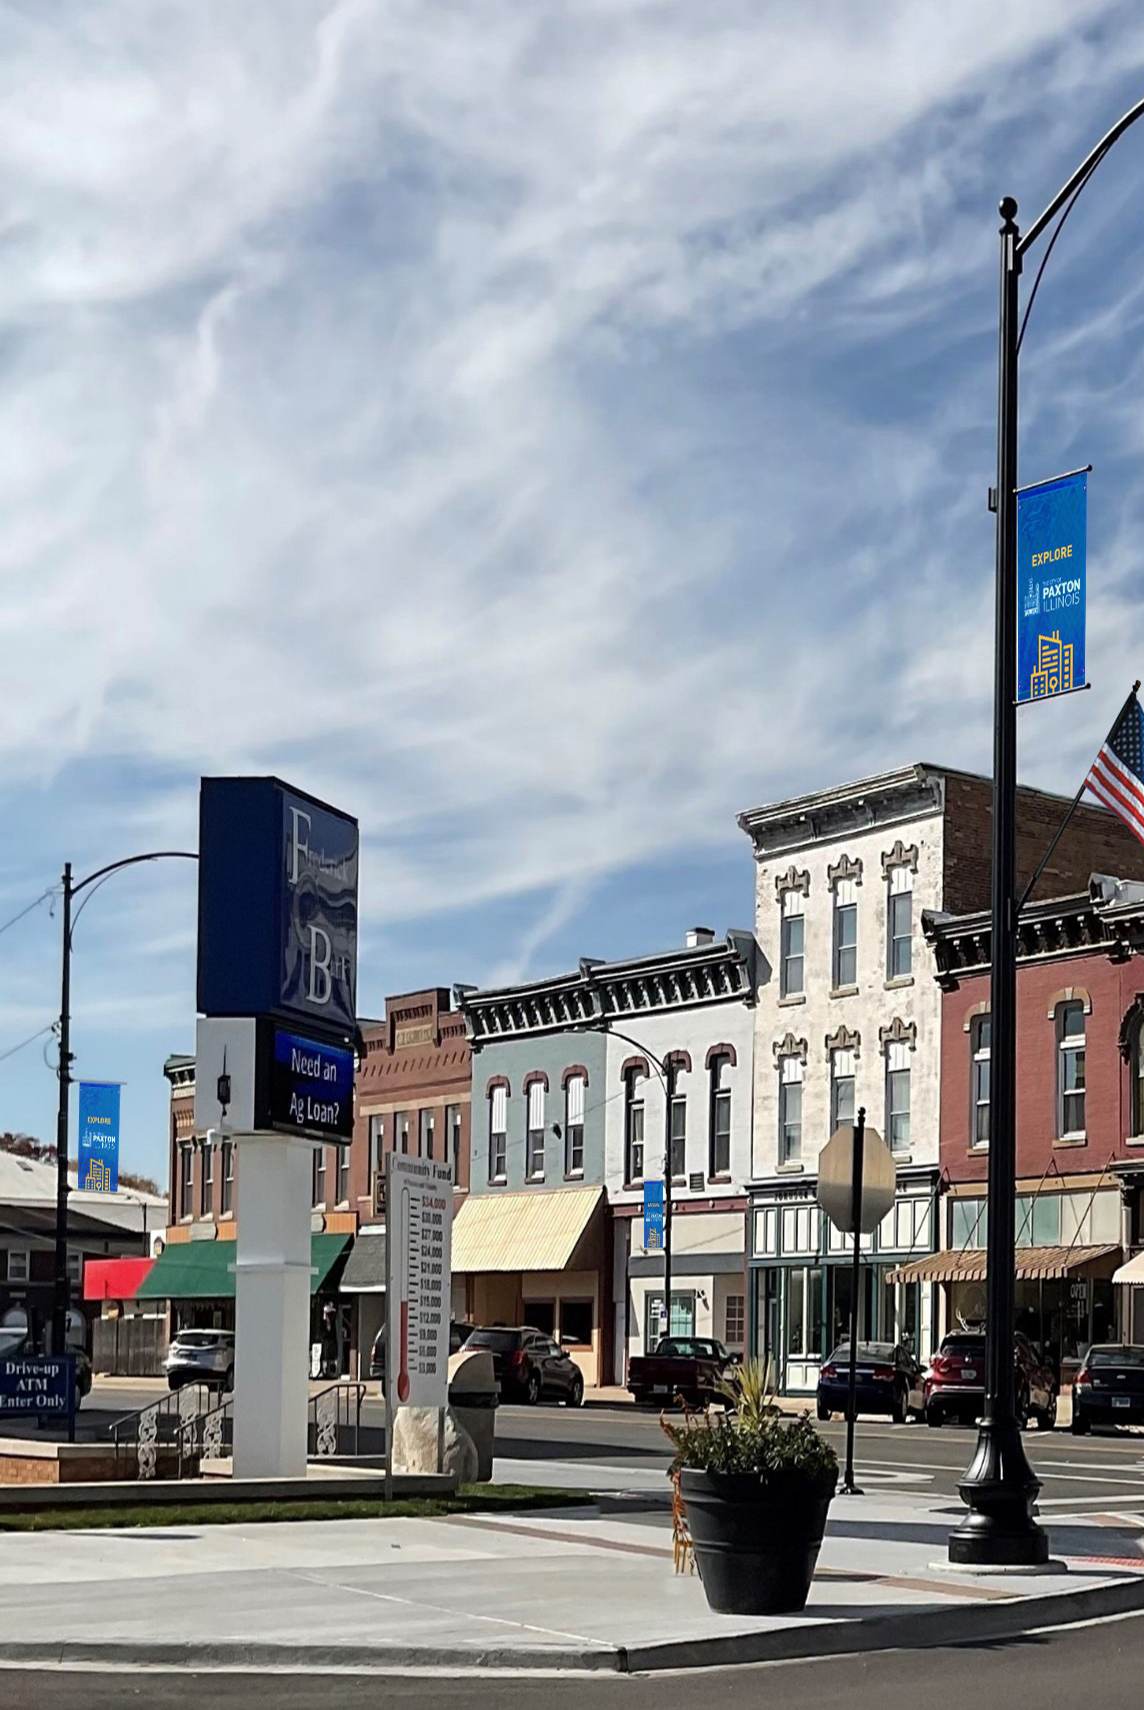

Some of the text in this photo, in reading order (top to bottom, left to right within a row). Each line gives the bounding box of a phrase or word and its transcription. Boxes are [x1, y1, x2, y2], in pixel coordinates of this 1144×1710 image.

[1032, 544, 1073, 567] EXPLORE
[1043, 578, 1081, 600] PAXTON
[1043, 591, 1080, 613] ILLINOIS
[292, 1048, 337, 1082] Need an
[290, 1092, 340, 1125] Ag Loan?
[432, 1164, 452, 1181] Fund
[421, 1228, 443, 1243] $27,000
[6, 1361, 59, 1378] Drive-up
[16, 1378, 48, 1392] ATM
[0, 1394, 66, 1410] Enter Only
